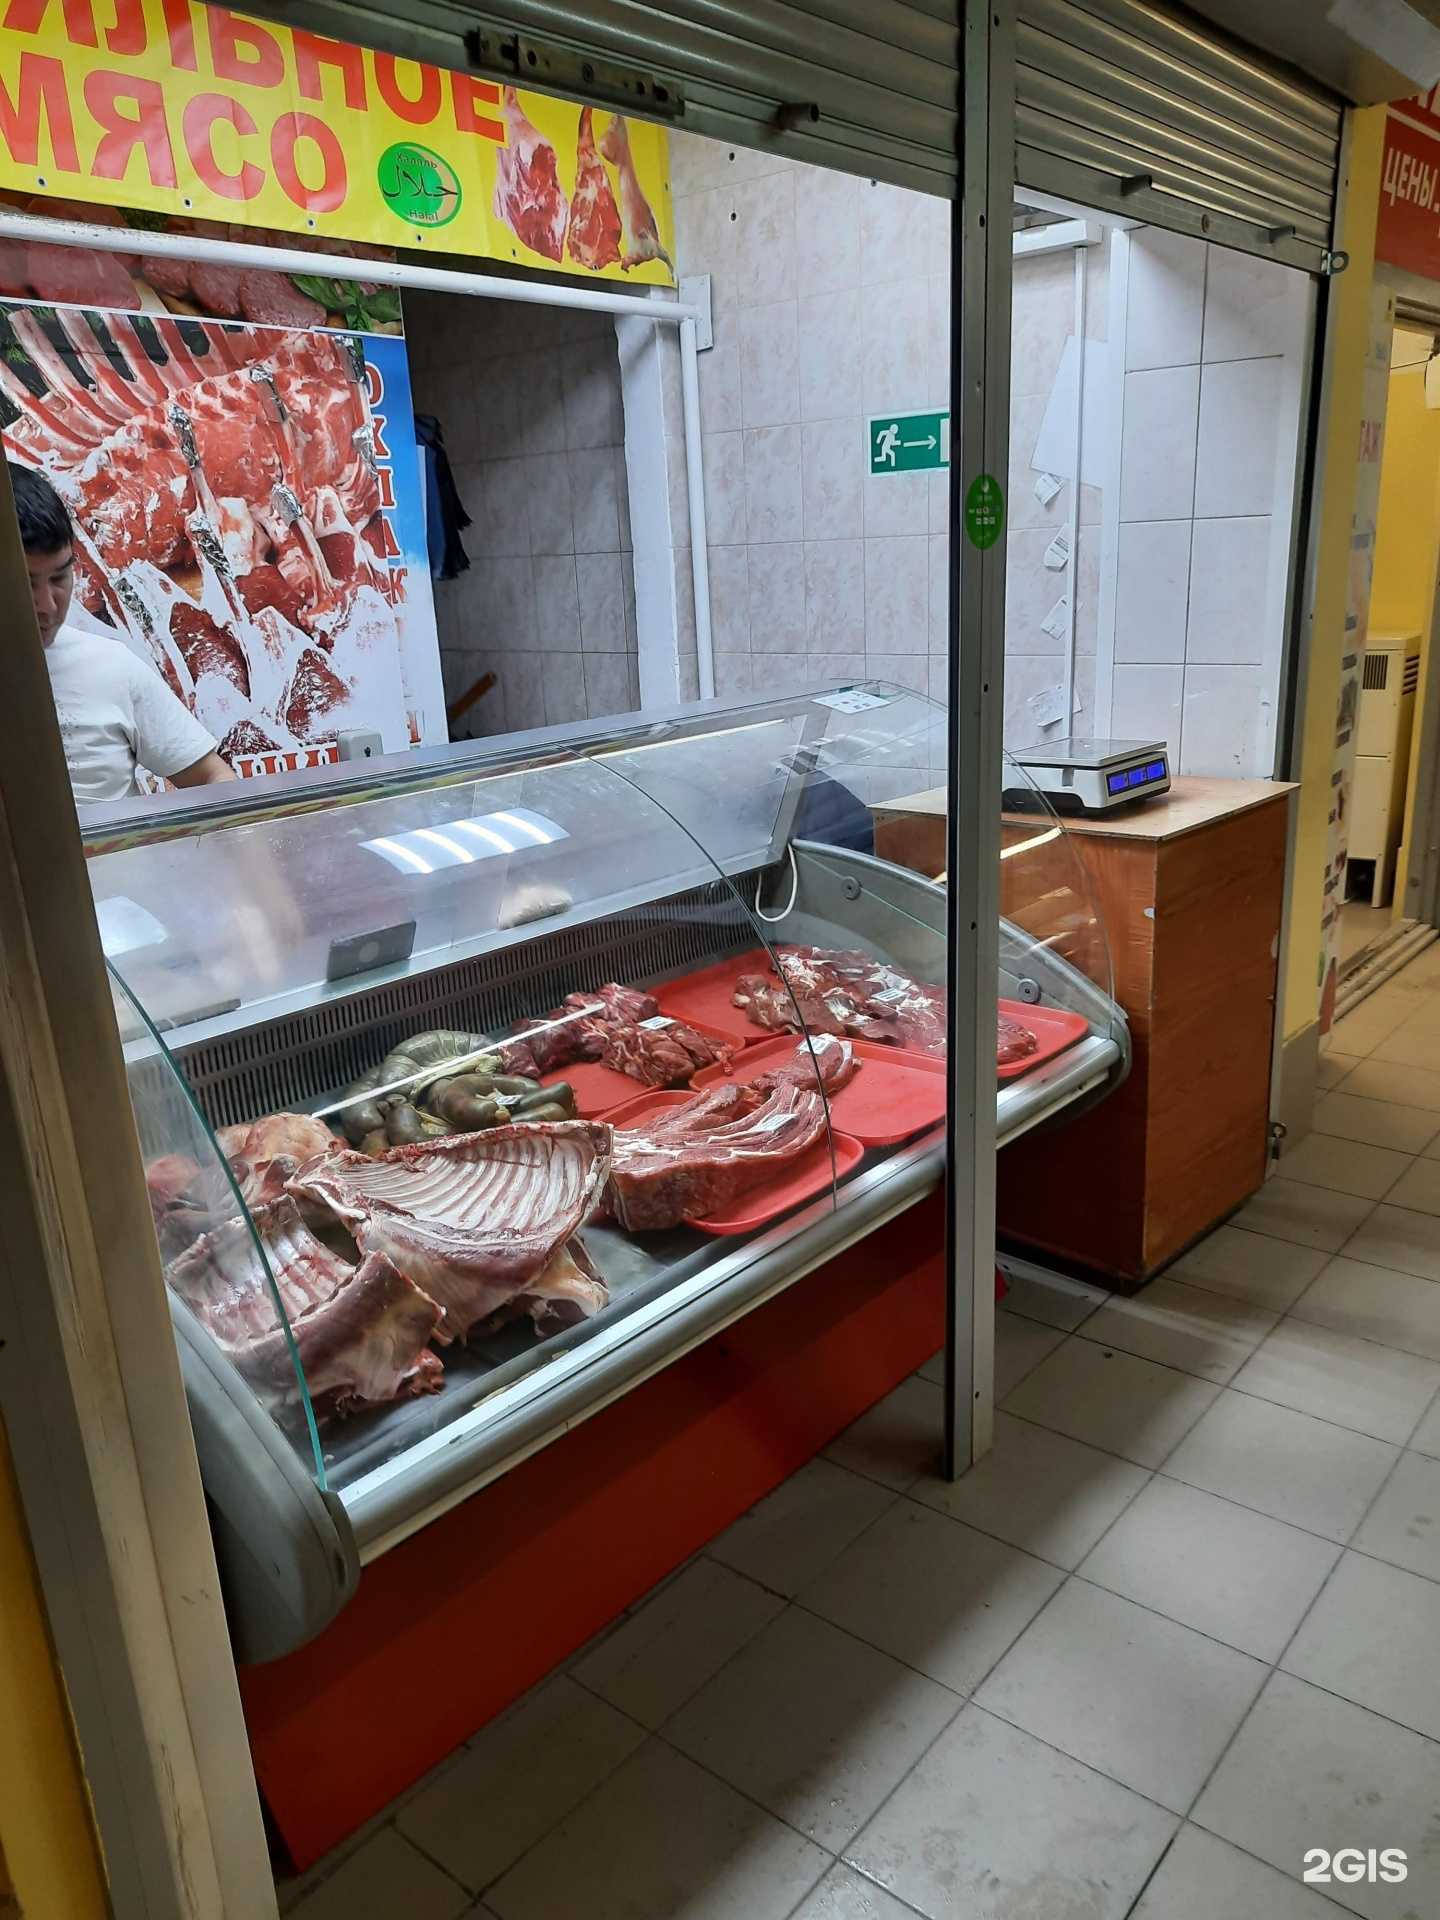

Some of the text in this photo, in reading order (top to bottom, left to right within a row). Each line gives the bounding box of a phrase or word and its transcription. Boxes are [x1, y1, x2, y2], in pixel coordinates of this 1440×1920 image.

[0, 51, 347, 213] МЯСО
[381, 165, 458, 198] حلال
[409, 208, 439, 221] Halal
